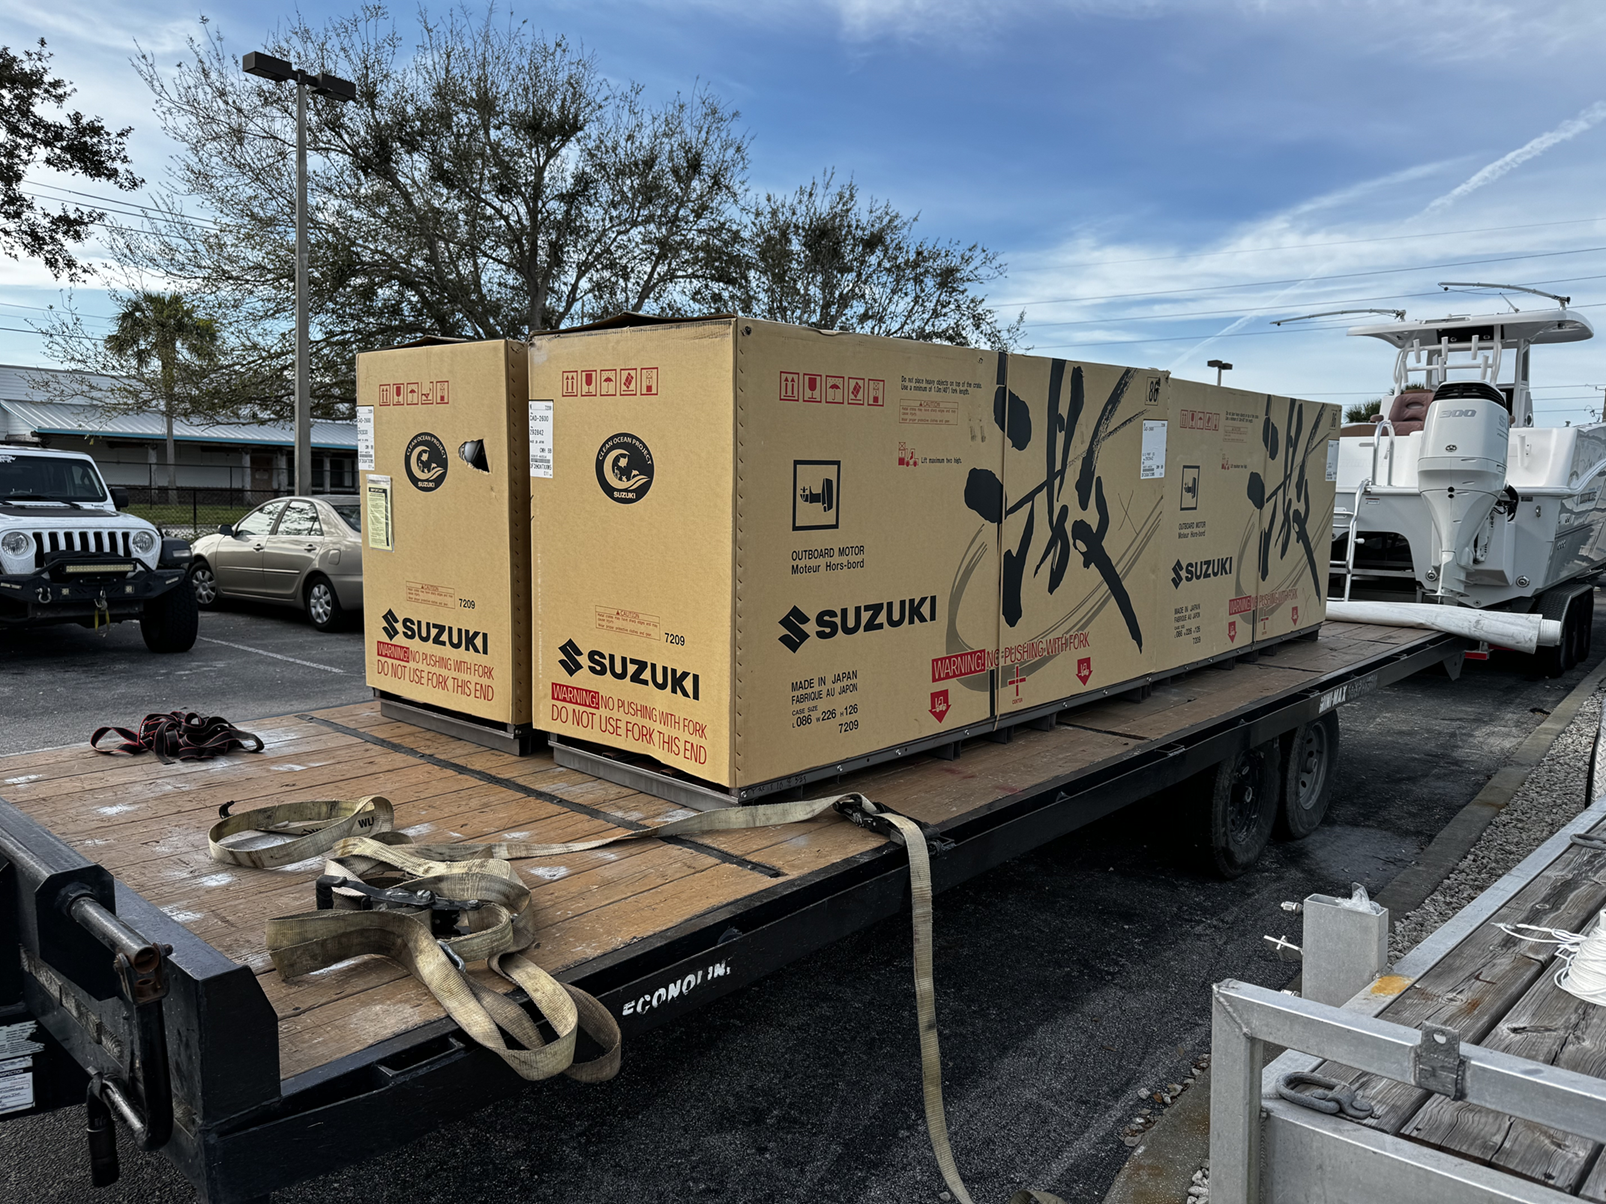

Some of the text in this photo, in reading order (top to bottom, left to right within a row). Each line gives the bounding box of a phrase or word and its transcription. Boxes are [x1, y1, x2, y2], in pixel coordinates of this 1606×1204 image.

[901, 375, 907, 383] Do
[914, 377, 924, 385] place
[925, 378, 935, 386] heavy
[1440, 409, 1477, 419] 300
[598, 436, 652, 465] CLEAN OCEAN PROJECT
[613, 491, 636, 499] SUZUKI
[791, 545, 865, 561] OUTBOARD MOTOR
[791, 558, 865, 575] Moteur Hors-bord
[1184, 556, 1233, 582] SUZUKI
[459, 598, 475, 609] 7209
[620, 610, 640, 619] CAUTION
[815, 595, 937, 640] SUZUKI
[402, 617, 488, 655] SUZUKI
[664, 632, 685, 647] 7209
[377, 643, 495, 681] WARNING! NO PUSHING WITH FORK
[933, 631, 1090, 679] WARNING! NO PUSHING WITH FORK
[377, 659, 495, 702] DO NOT USE FORK THIS END
[587, 649, 699, 701] SUZUKI
[791, 670, 858, 692] MADE IN JAPAN
[791, 683, 858, 705] FABRIQUE AU JAPON
[553, 683, 708, 740] WARNING! NO PUSHING WITH FORK
[791, 705, 818, 716] CASE SIZE
[551, 703, 707, 765] DO NOT USE FORK THIS END
[838, 719, 859, 734] 7209
